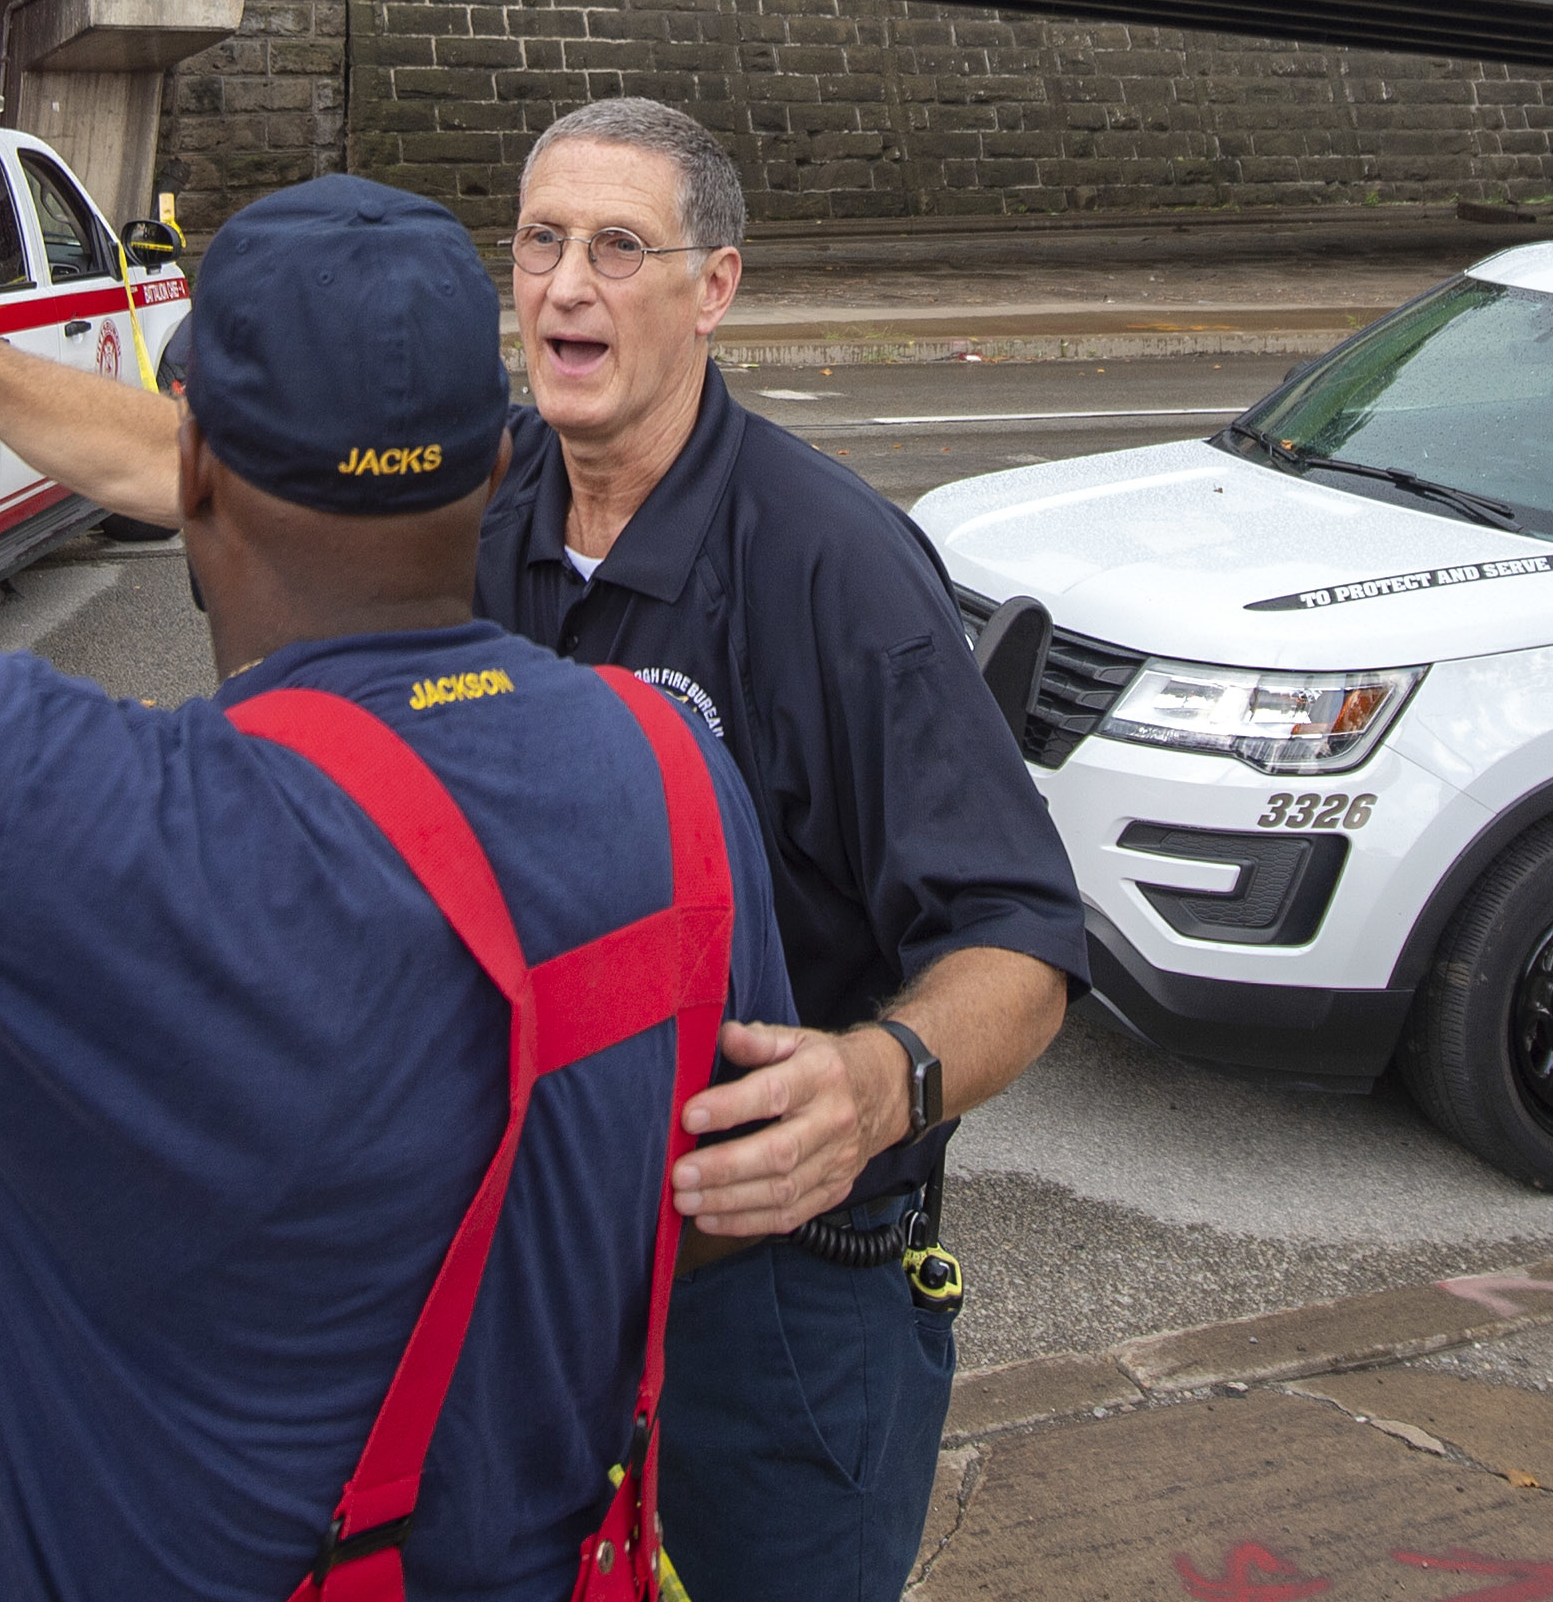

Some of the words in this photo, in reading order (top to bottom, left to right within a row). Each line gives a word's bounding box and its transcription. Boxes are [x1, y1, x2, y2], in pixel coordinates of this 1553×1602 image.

[338, 444, 443, 476] JACKS
[1299, 590, 1332, 608] TO
[1334, 572, 1433, 602] PROTECT
[1437, 566, 1481, 586] AND
[1482, 557, 1551, 579] SERVE
[409, 668, 515, 710] JACKSON
[661, 668, 692, 693] FIRE
[1256, 792, 1379, 830] 3326
